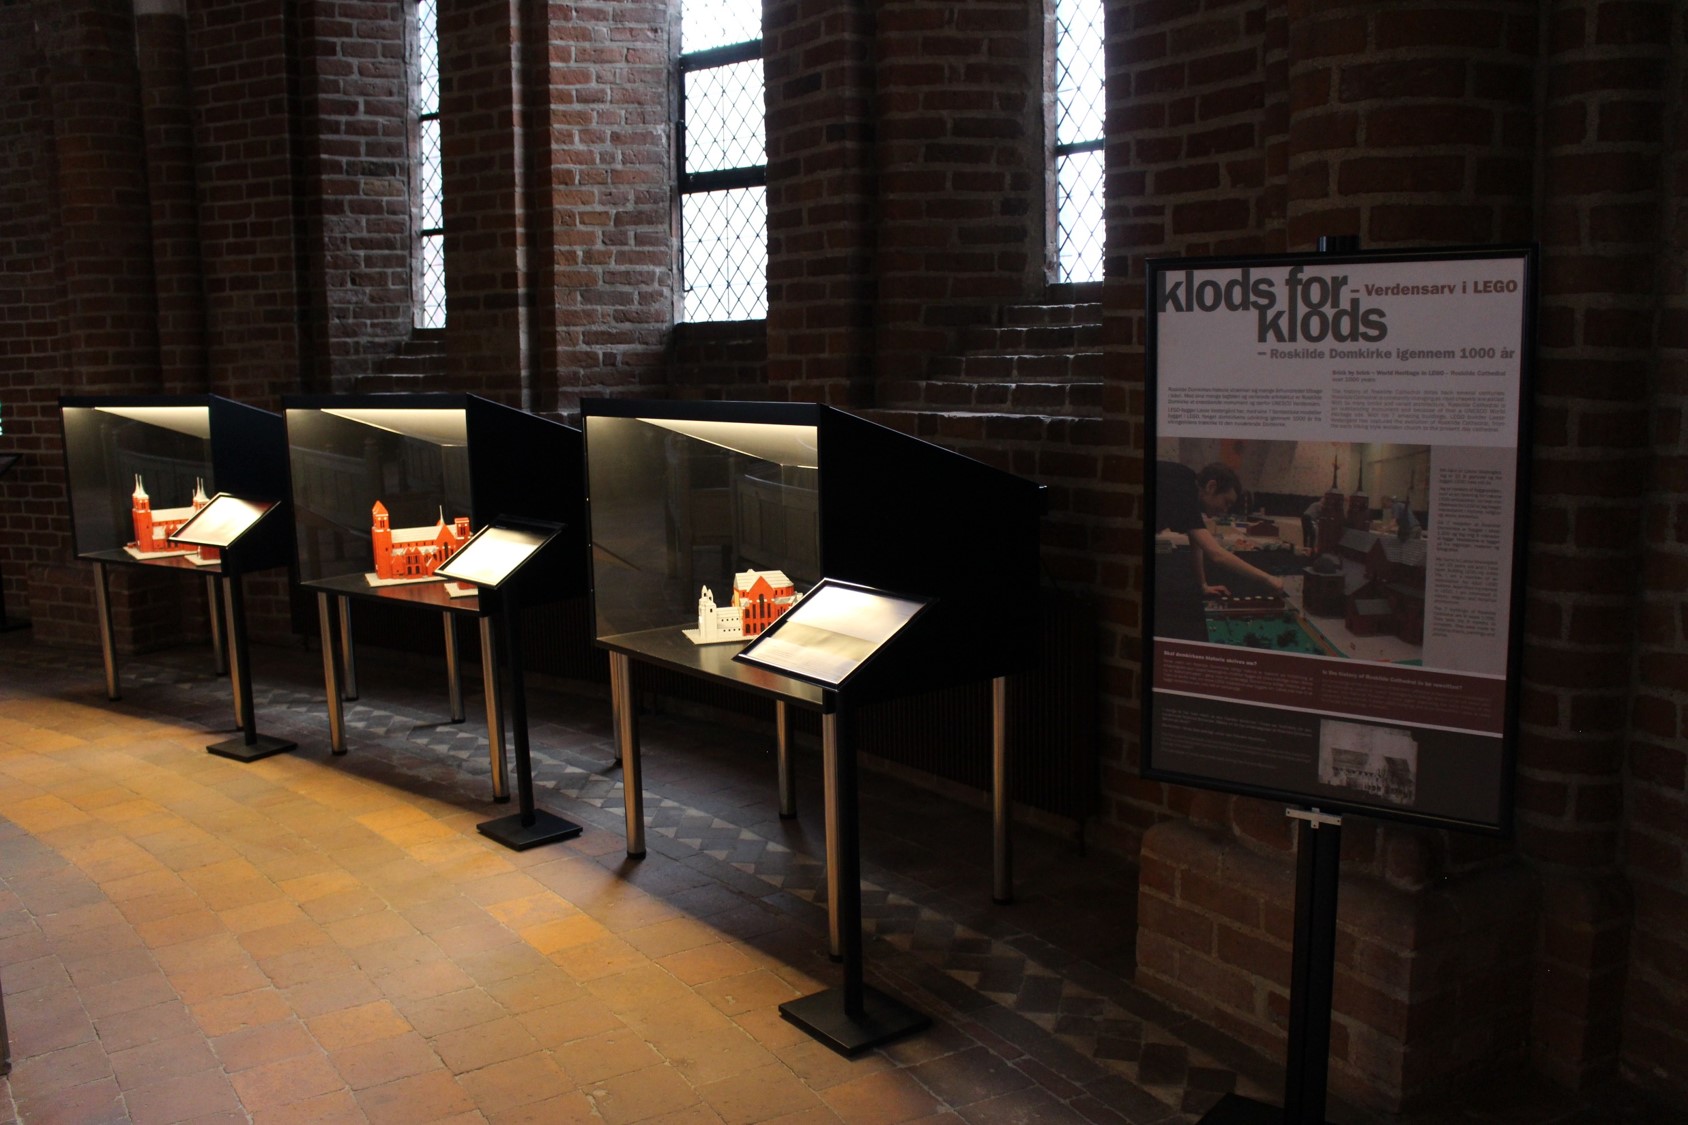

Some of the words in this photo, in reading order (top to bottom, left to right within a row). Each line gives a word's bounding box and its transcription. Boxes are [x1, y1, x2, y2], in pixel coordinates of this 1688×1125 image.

[1157, 269, 1277, 312] klods
[1285, 266, 1348, 310] for
[1365, 282, 1456, 296] Verdensarv
[1462, 281, 1467, 294] i
[1473, 279, 1518, 294] LEGO
[1257, 298, 1388, 343] klods
[1270, 348, 1325, 360] Roskilde
[1329, 348, 1392, 360] Domkirke
[1396, 348, 1455, 362] igennem
[1459, 347, 1496, 359] 1000
[1500, 346, 1516, 359] år
